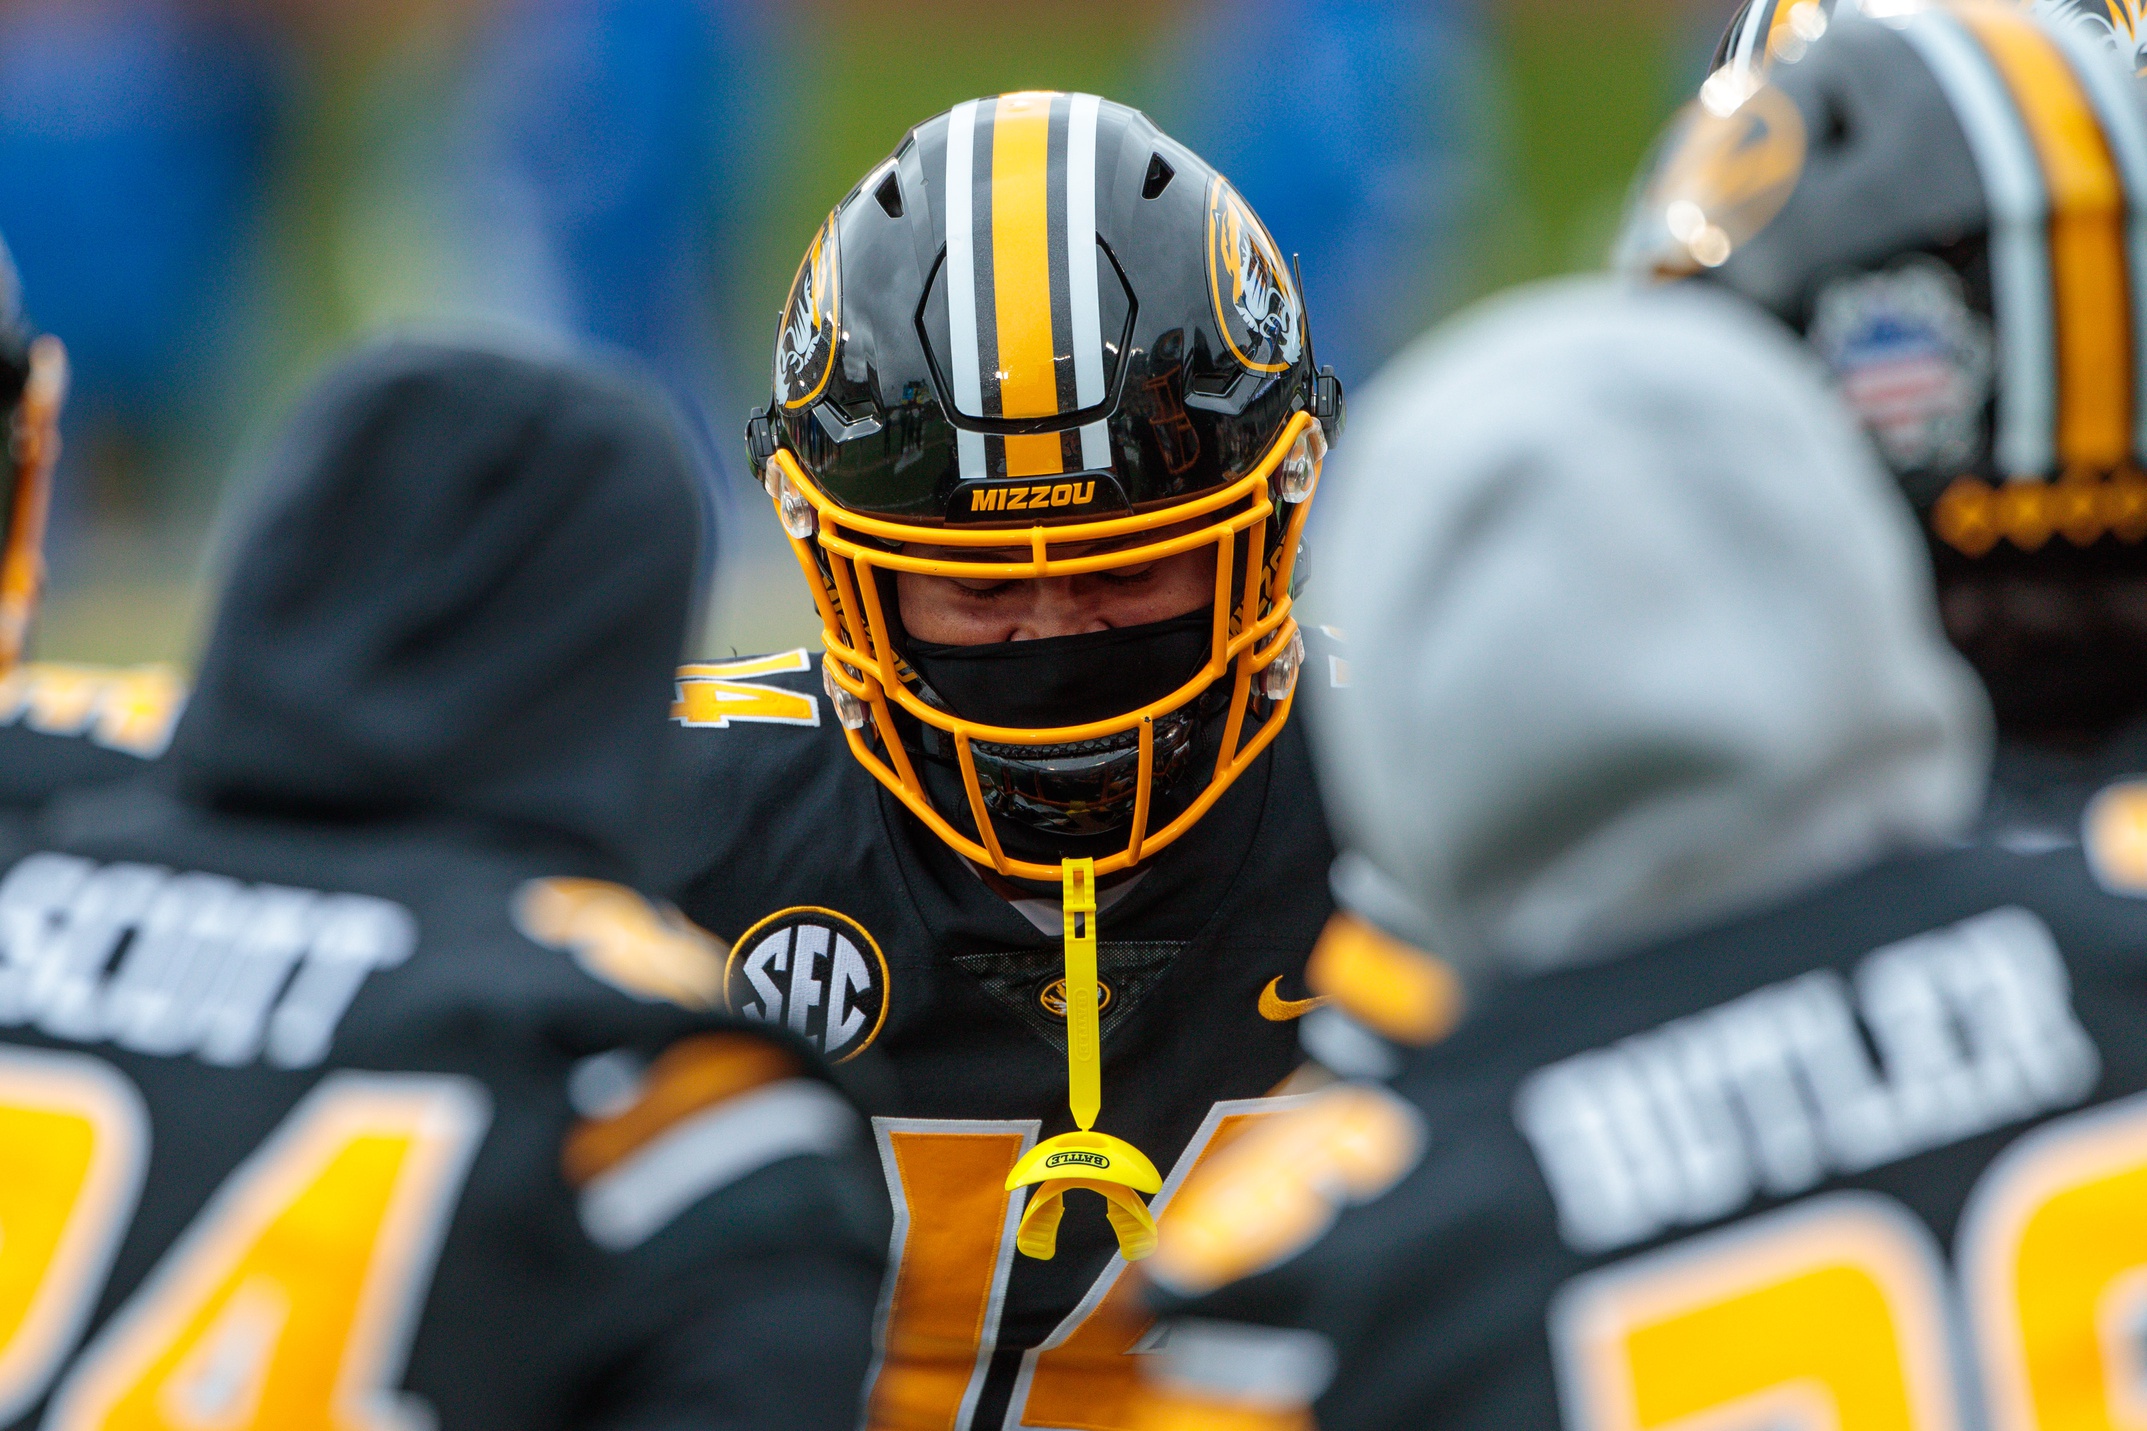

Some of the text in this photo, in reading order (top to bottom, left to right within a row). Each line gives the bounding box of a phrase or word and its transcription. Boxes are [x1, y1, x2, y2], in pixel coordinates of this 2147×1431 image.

[971, 481, 1095, 511] MIZZOU
[742, 924, 872, 1054] SEC
[1051, 1153, 1105, 1167] BATTLE
